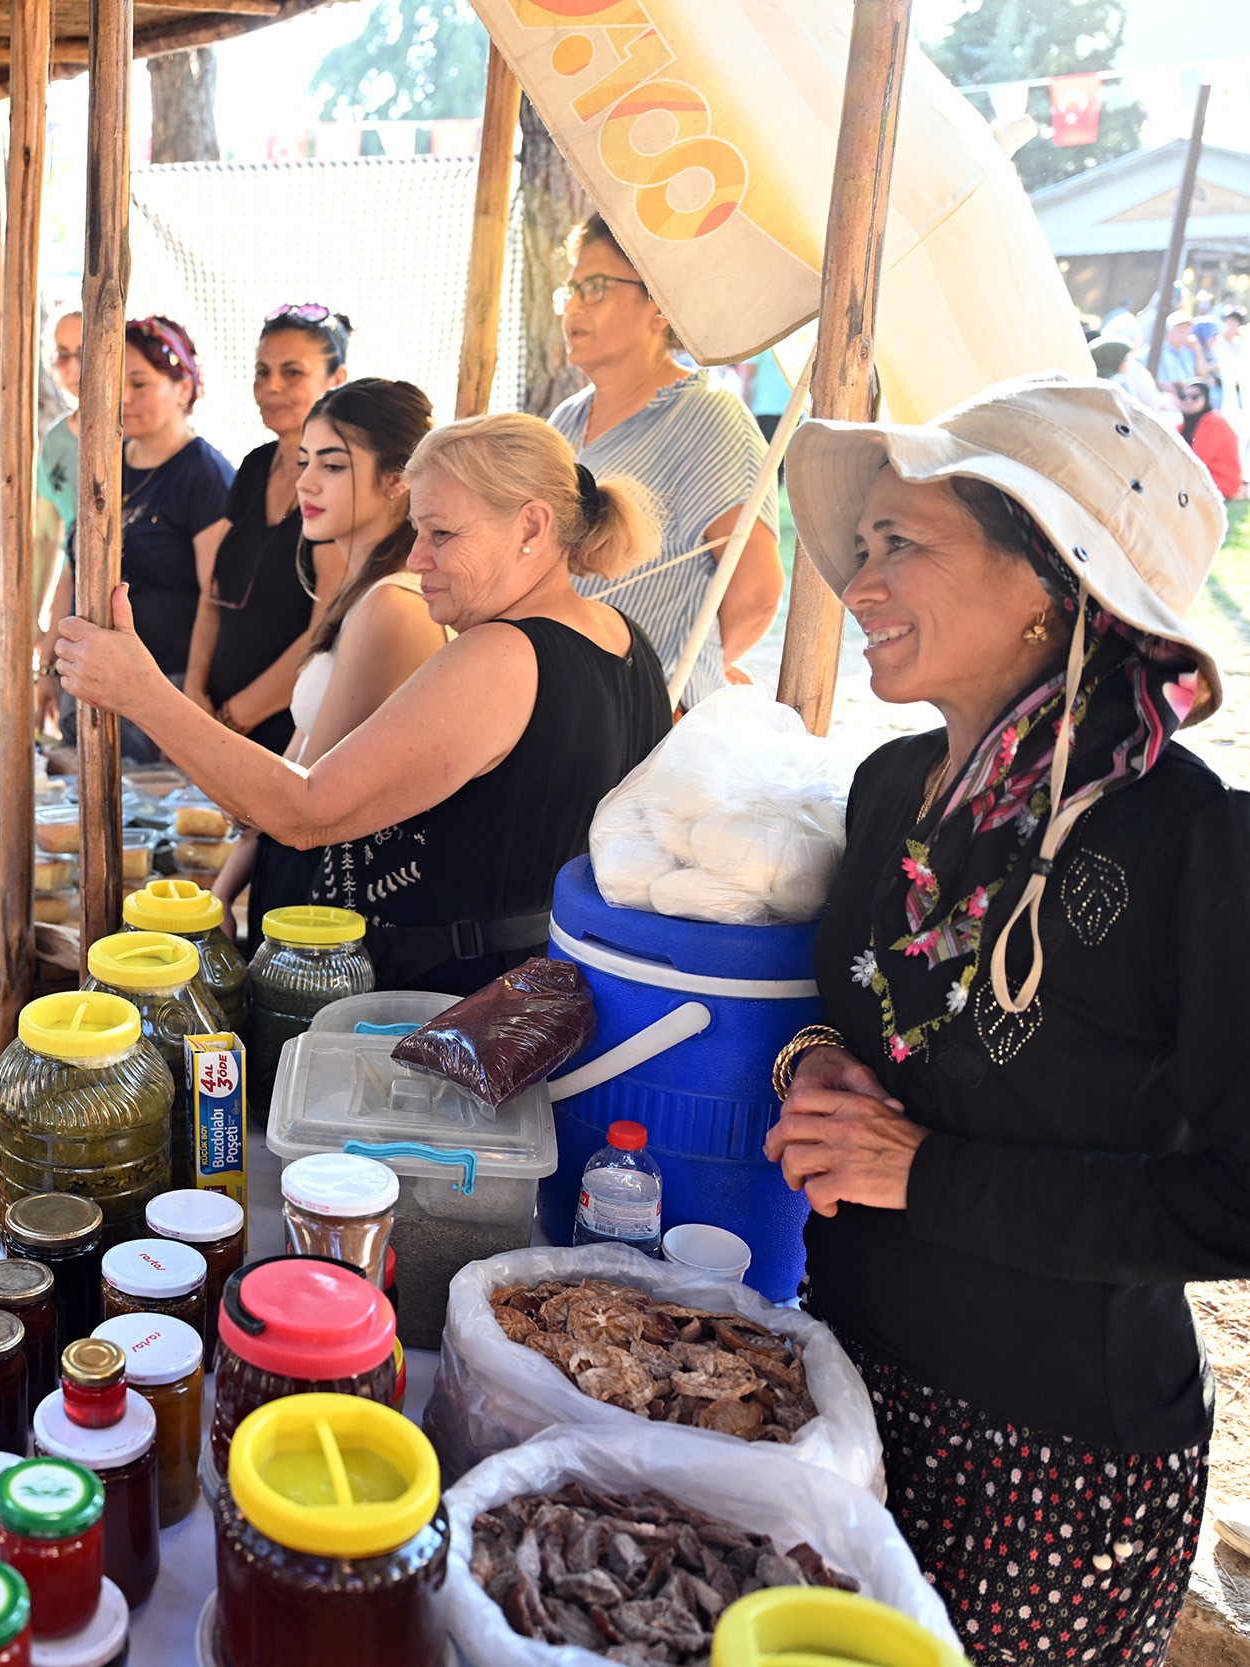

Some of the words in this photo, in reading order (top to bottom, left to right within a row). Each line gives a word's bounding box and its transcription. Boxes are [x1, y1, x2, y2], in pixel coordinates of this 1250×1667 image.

[205, 1064, 213, 1079] AL
[217, 1054, 227, 1078] ÖDE
[200, 1078, 216, 1093] 4
[217, 1077, 233, 1091] 3
[200, 1125, 208, 1140] BOY
[210, 1108, 225, 1168] Buzdolabı
[199, 1141, 208, 1165] KÜÇÜK
[225, 1126, 241, 1164] Poşeti
